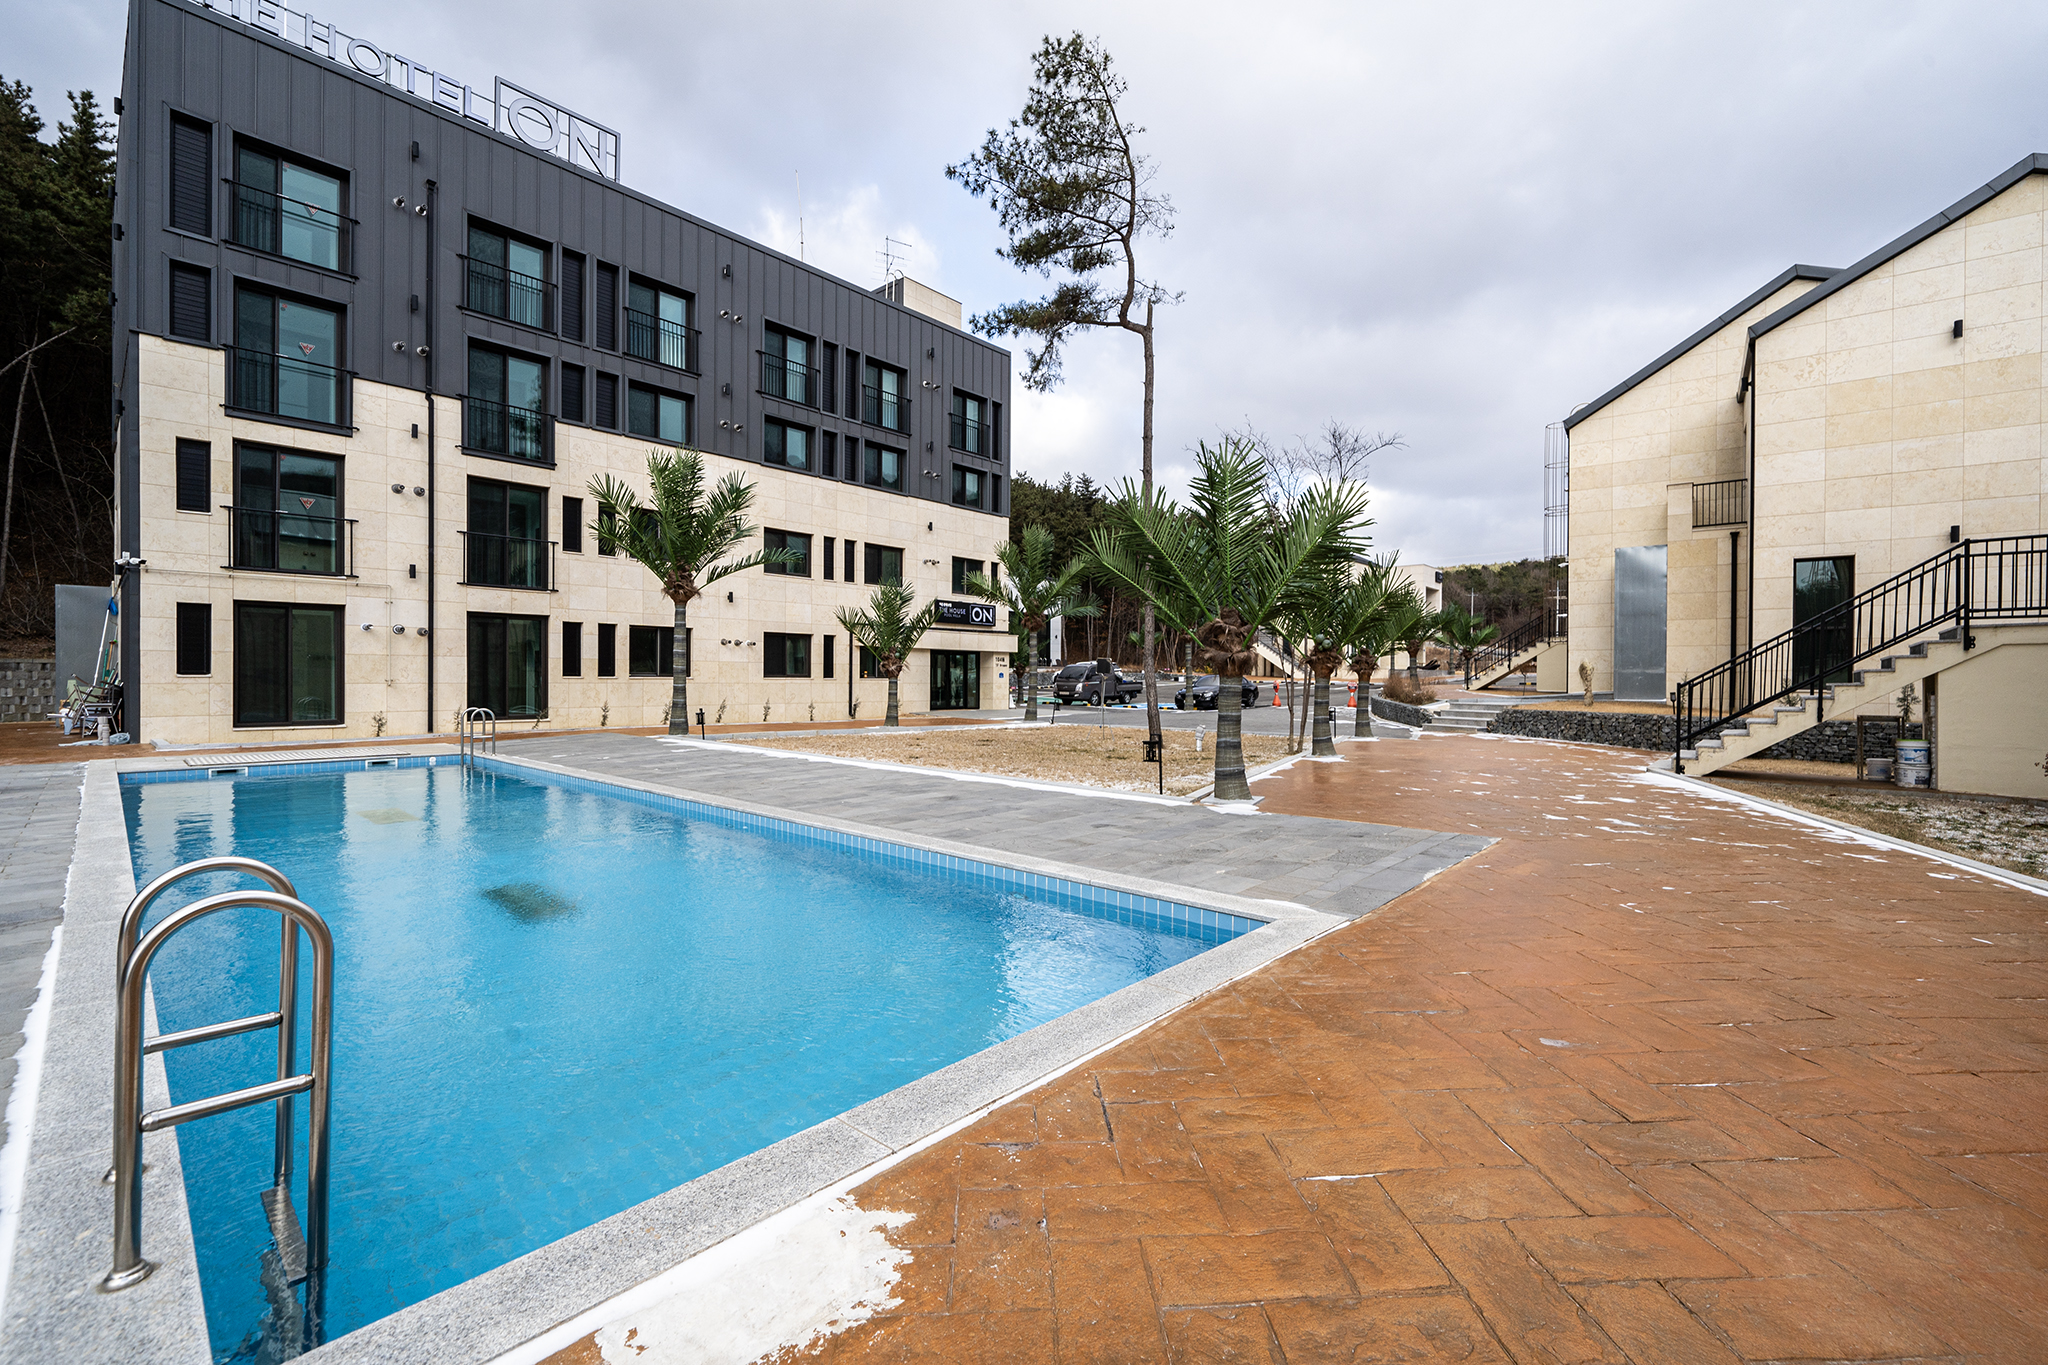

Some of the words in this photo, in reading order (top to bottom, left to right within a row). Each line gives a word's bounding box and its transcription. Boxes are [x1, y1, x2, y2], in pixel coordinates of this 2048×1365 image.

[305, 13, 489, 126] HOTEL
[508, 98, 608, 179] ON
[949, 607, 966, 615] HOUSE
[972, 607, 993, 622] ON
